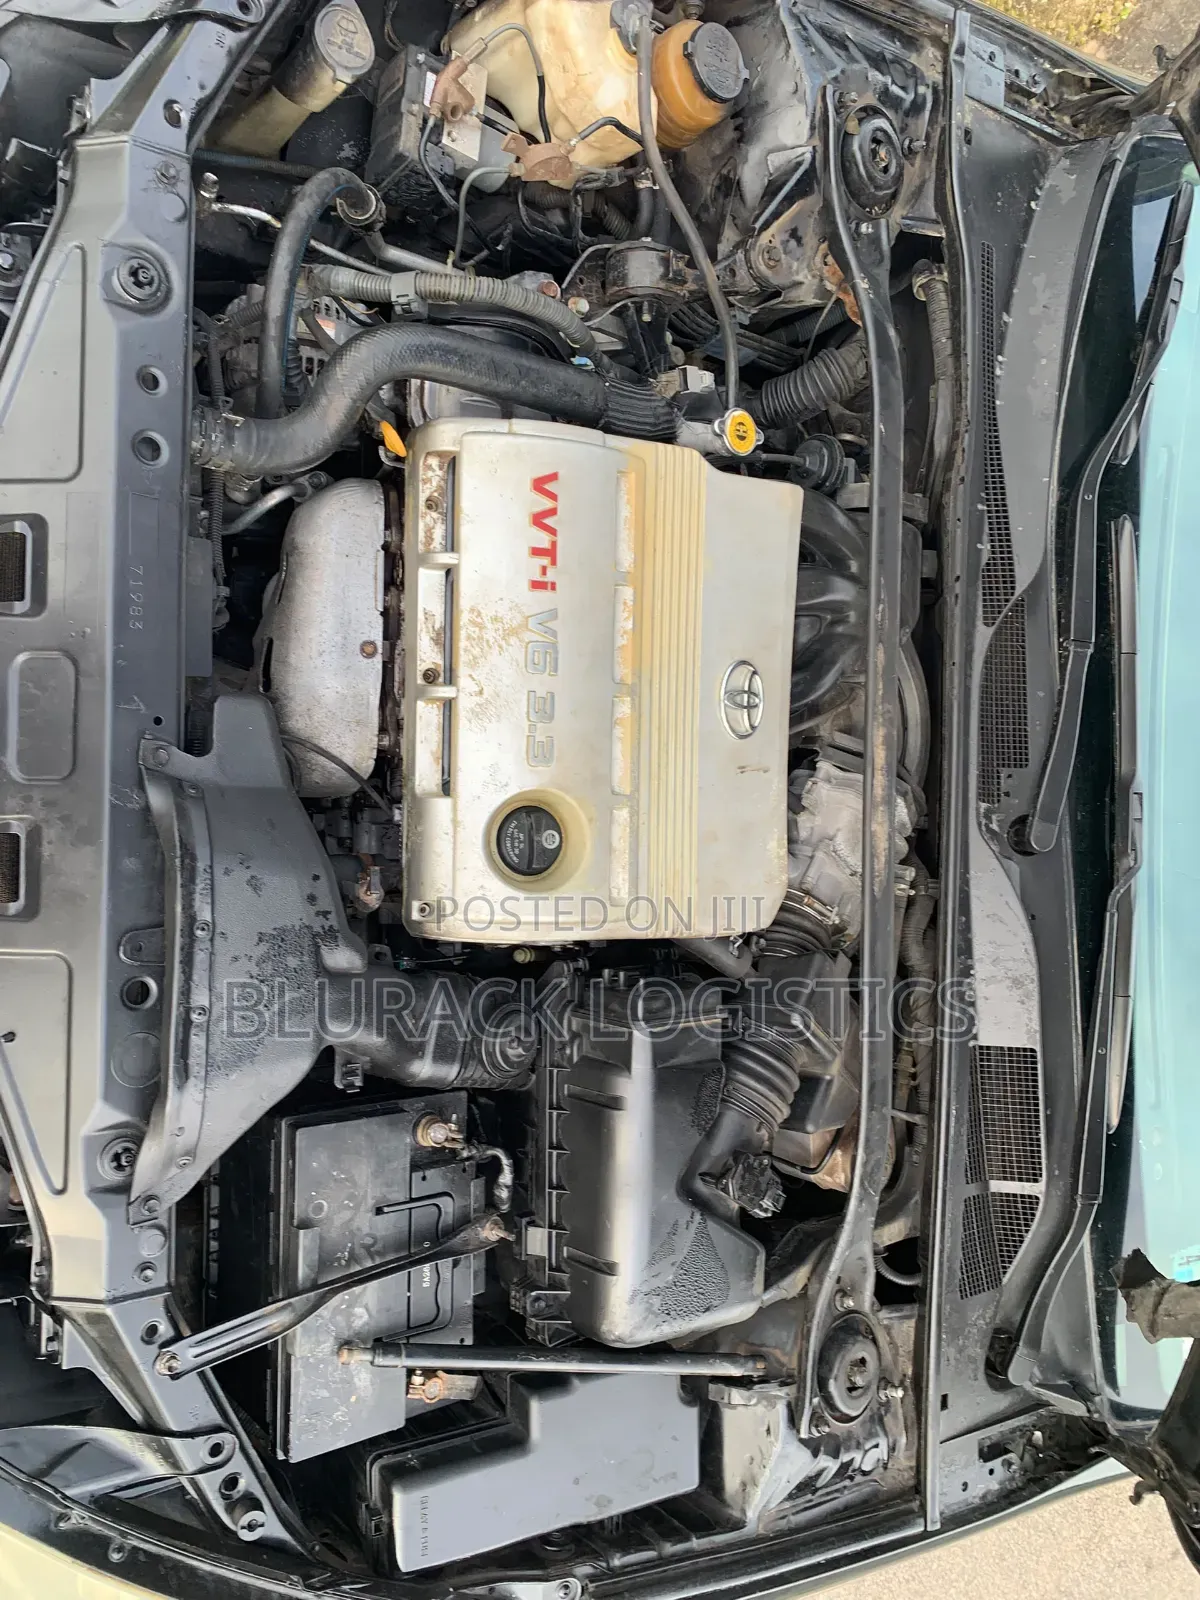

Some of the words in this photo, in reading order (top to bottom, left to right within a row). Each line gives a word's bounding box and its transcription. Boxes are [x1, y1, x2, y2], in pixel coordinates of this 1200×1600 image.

[529, 470, 559, 592] VVT-i
[129, 564, 144, 630] 71983
[525, 608, 559, 677] V6
[526, 690, 556, 768] 3.3
